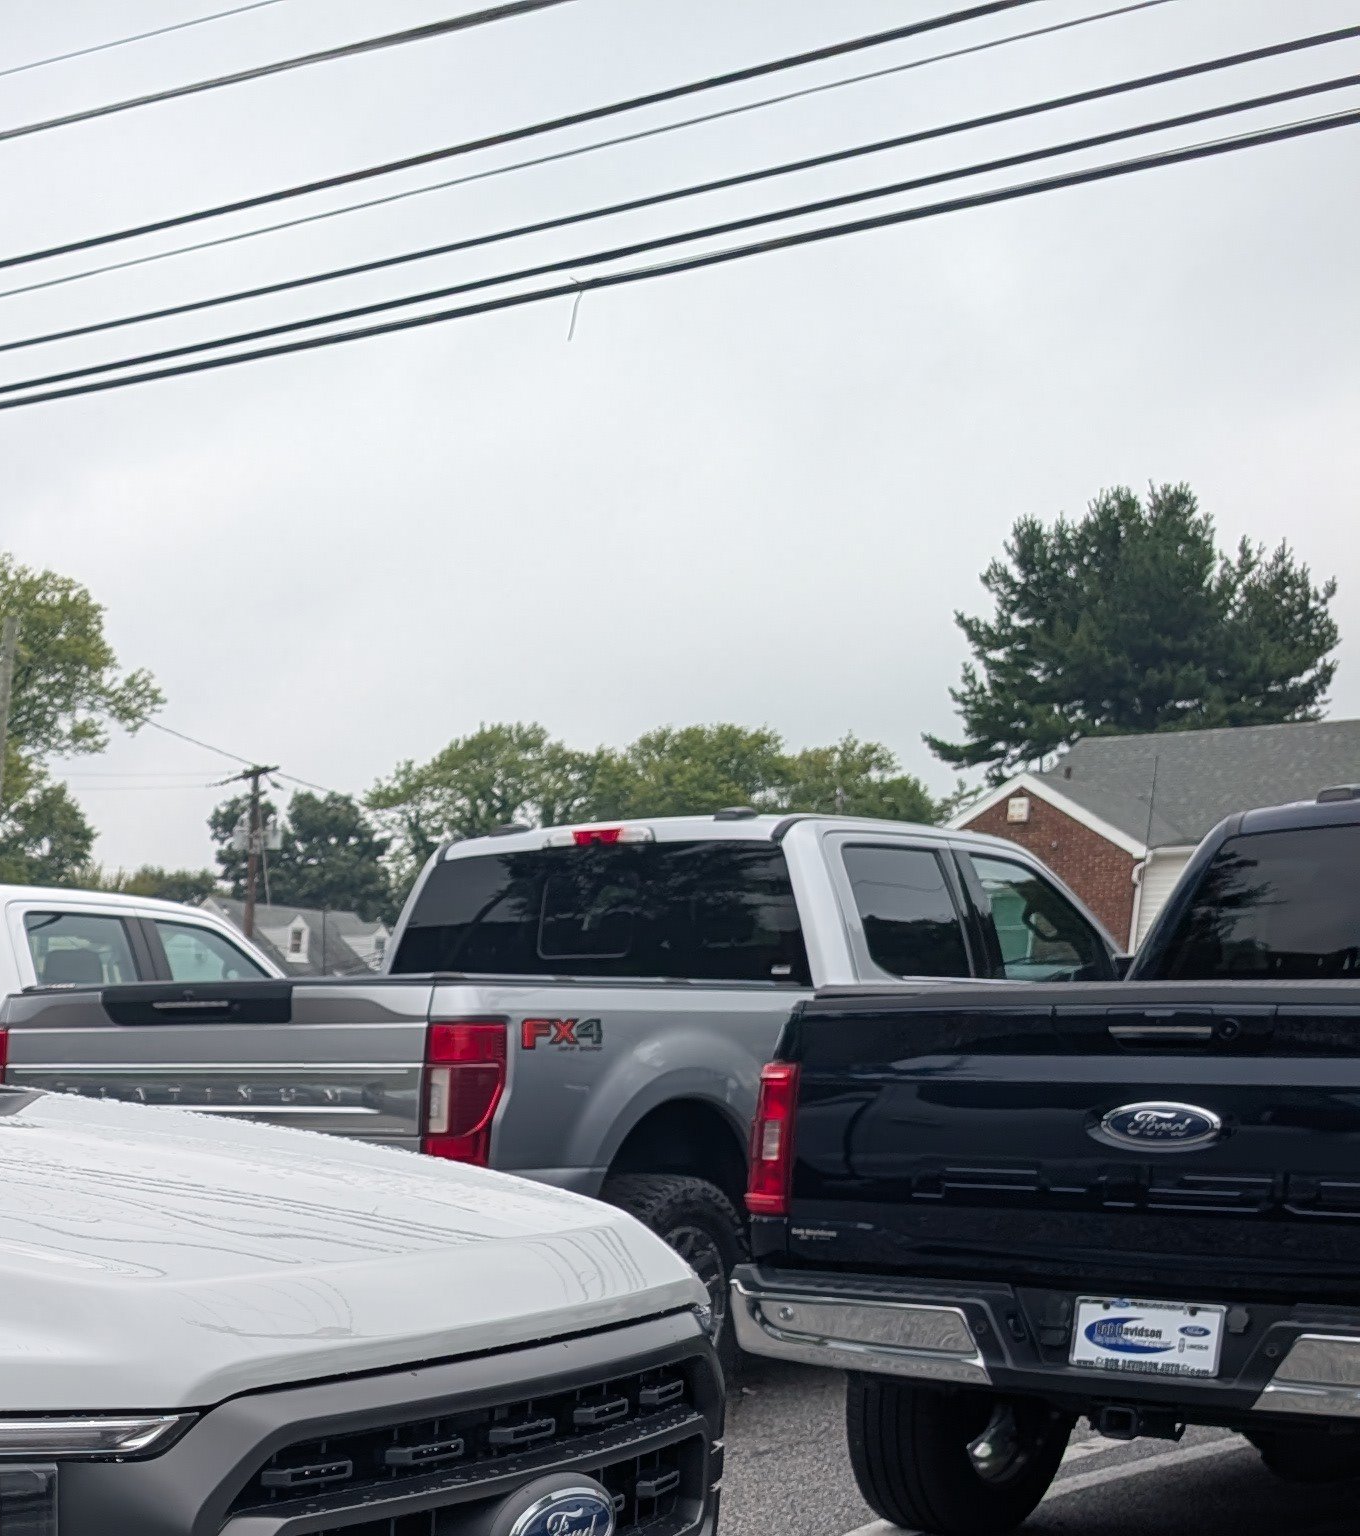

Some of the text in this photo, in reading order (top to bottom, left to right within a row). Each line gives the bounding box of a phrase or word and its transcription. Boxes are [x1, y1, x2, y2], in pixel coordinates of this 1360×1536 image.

[521, 1017, 603, 1050] FX4
[1126, 1110, 1192, 1137] Ford
[1116, 1322, 1162, 1341] Davidson
